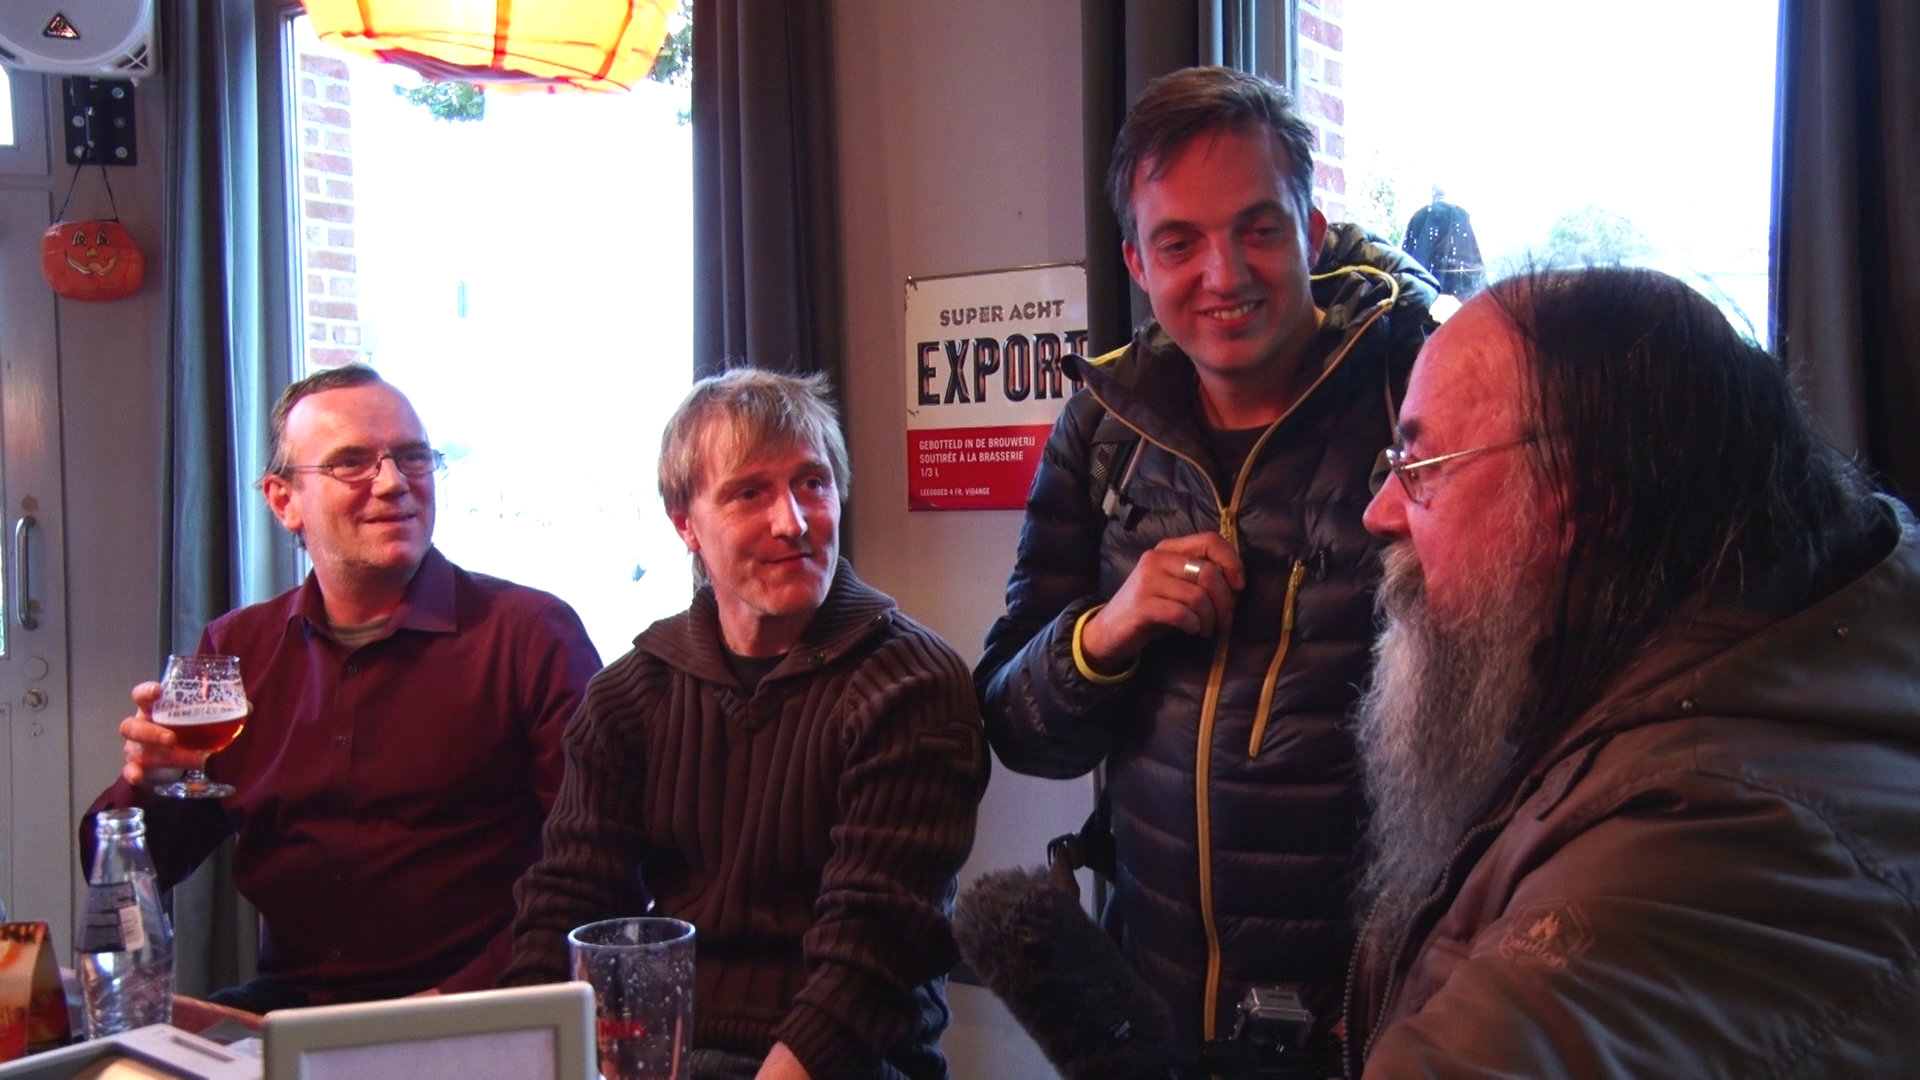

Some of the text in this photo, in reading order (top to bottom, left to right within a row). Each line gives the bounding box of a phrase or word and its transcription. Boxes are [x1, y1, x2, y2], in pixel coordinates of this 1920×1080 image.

[940, 300, 1065, 327] SUPER ACHT
[917, 329, 1088, 406] EXPORT
[919, 436, 1035, 450] GEBOTTELD IN DE BROUWERIJ
[919, 451, 1024, 464] SOUTIRÉE À LA BRASSERIE
[920, 467, 933, 478] 1/3
